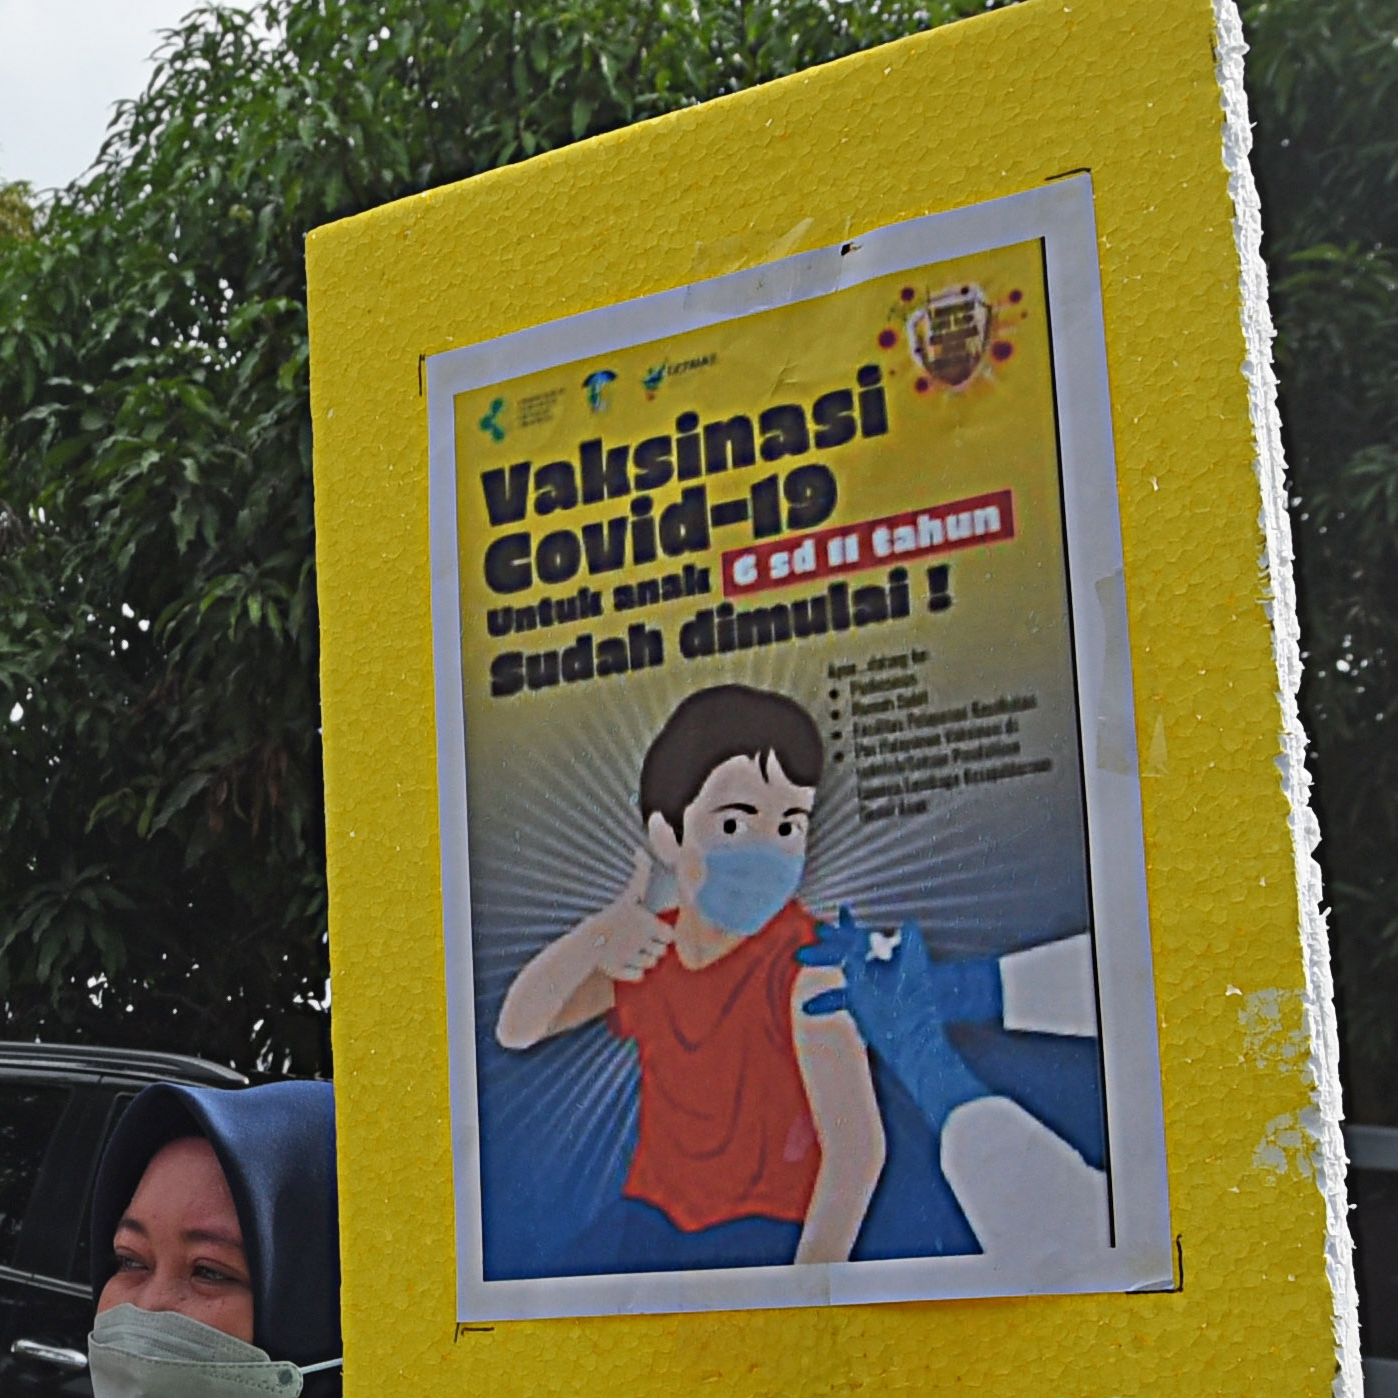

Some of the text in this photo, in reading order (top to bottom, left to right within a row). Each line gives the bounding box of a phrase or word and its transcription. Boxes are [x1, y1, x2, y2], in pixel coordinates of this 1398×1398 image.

[480, 364, 889, 527] Vaksinasi
[484, 463, 838, 594] Covid-19
[487, 586, 604, 637] Untuk
[613, 563, 711, 612] anak
[733, 553, 758, 586] 6
[769, 538, 816, 579] sd
[872, 505, 1000, 558] tahun
[490, 622, 664, 697] Sudah
[679, 566, 911, 659] dimulai
